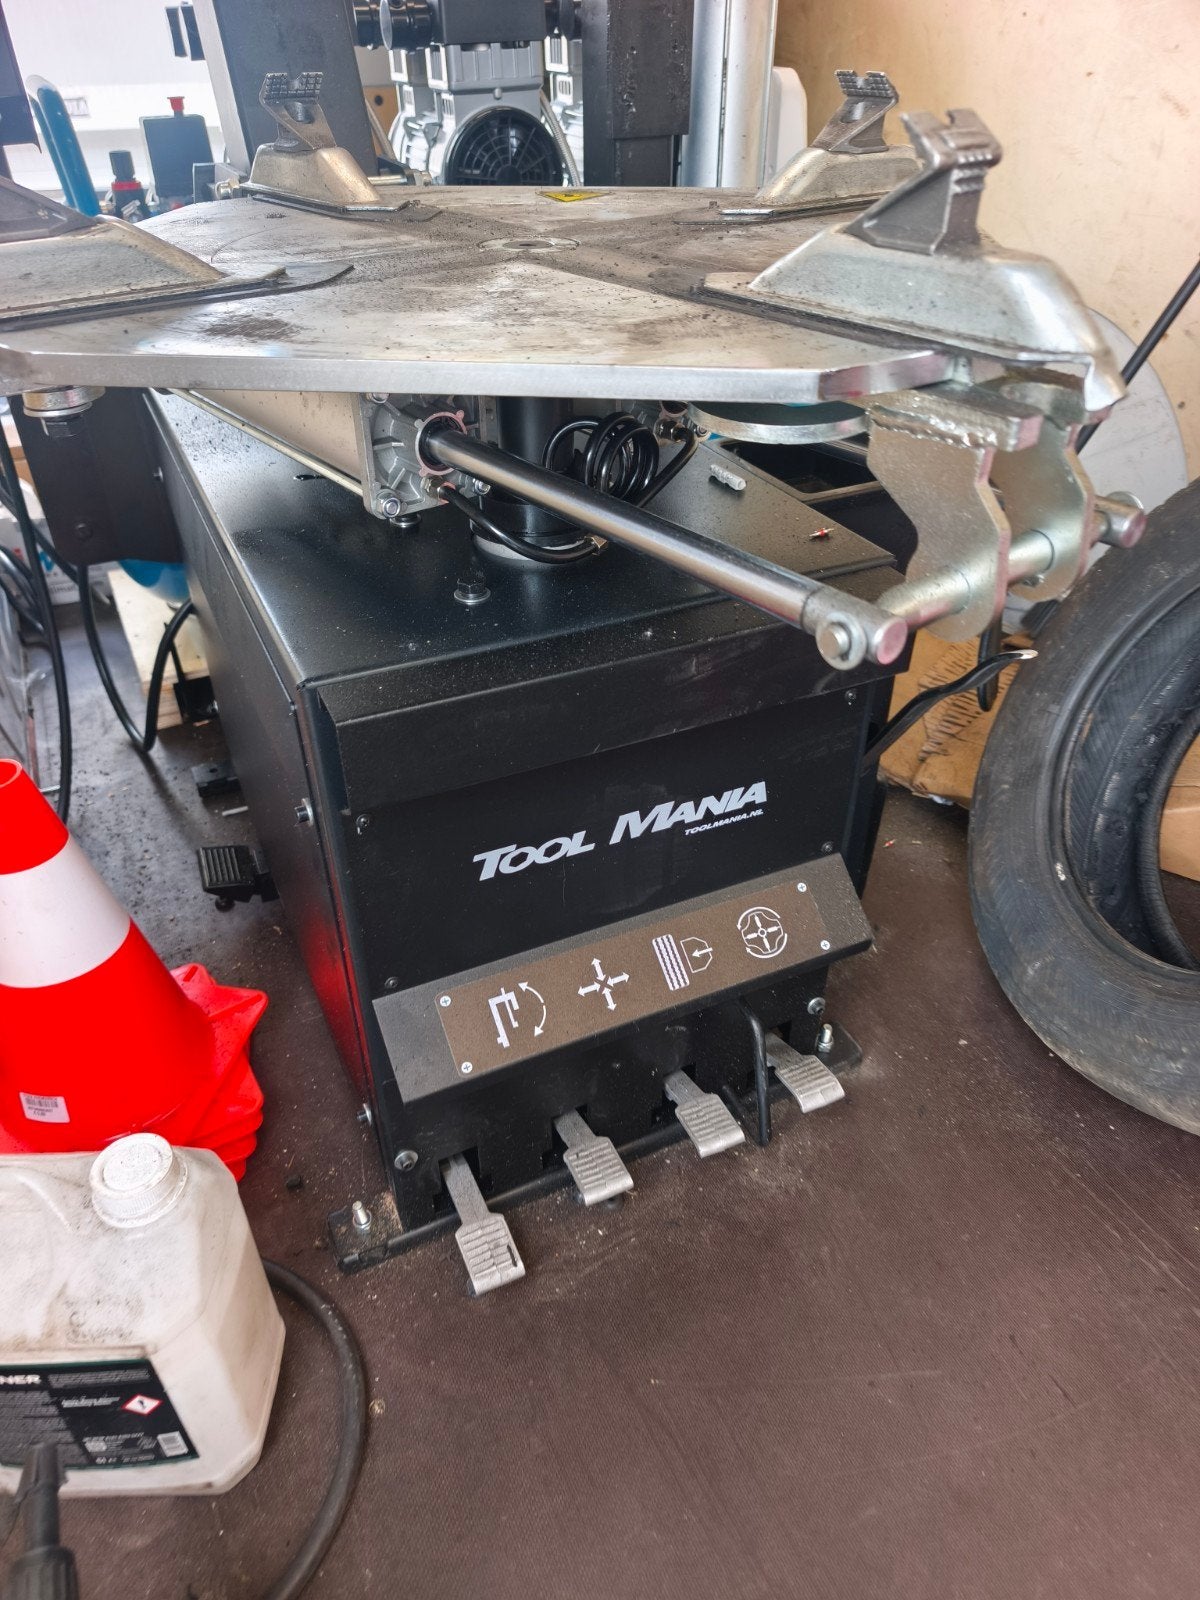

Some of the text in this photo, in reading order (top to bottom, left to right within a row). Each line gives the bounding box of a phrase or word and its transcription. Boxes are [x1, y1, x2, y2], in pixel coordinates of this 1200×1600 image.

[472, 781, 767, 881] TOOL MANIA
[684, 809, 764, 836] TOOLMANIA.NL
